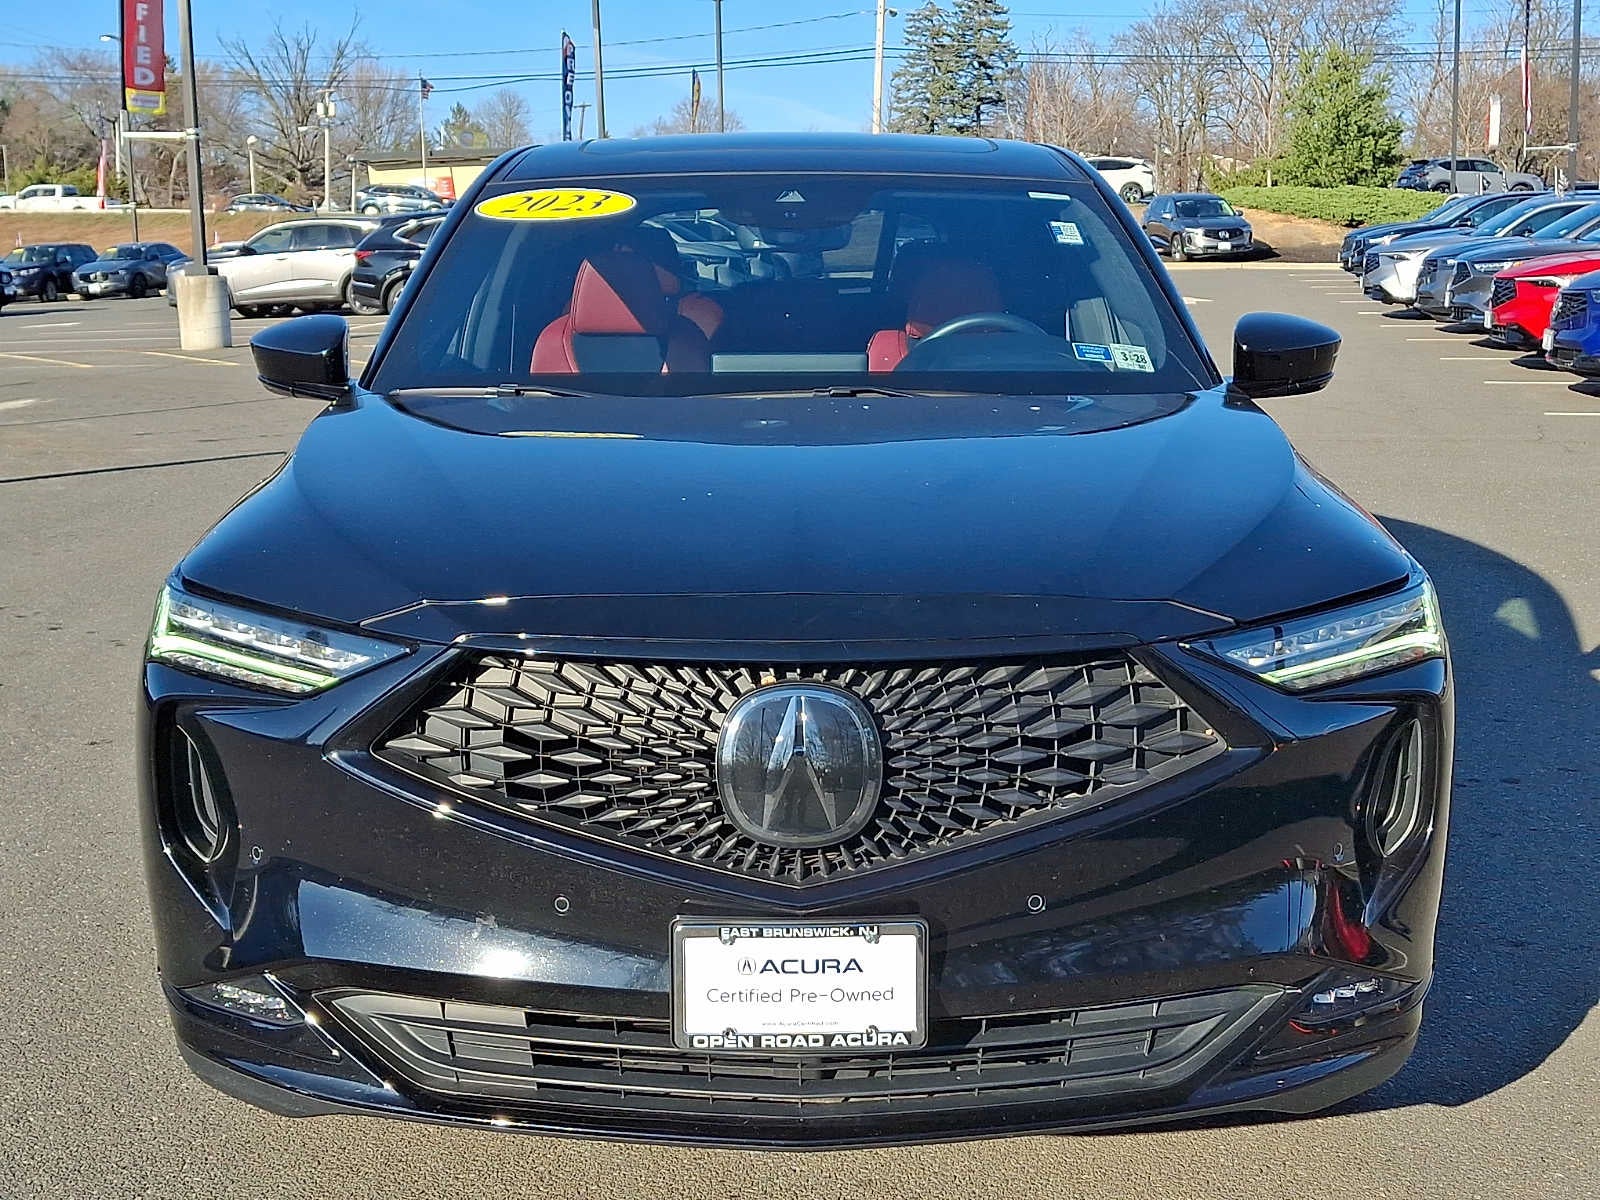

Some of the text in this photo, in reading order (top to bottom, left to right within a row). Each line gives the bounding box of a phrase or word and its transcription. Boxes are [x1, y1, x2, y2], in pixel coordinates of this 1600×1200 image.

[499, 194, 612, 214] 2023
[720, 927, 760, 938] EAST
[858, 925, 879, 937] NJ
[760, 957, 864, 975] ACURA
[706, 986, 895, 1003] Certified Pre-Owned
[692, 1031, 910, 1049] OPEN ROAD ACURA
